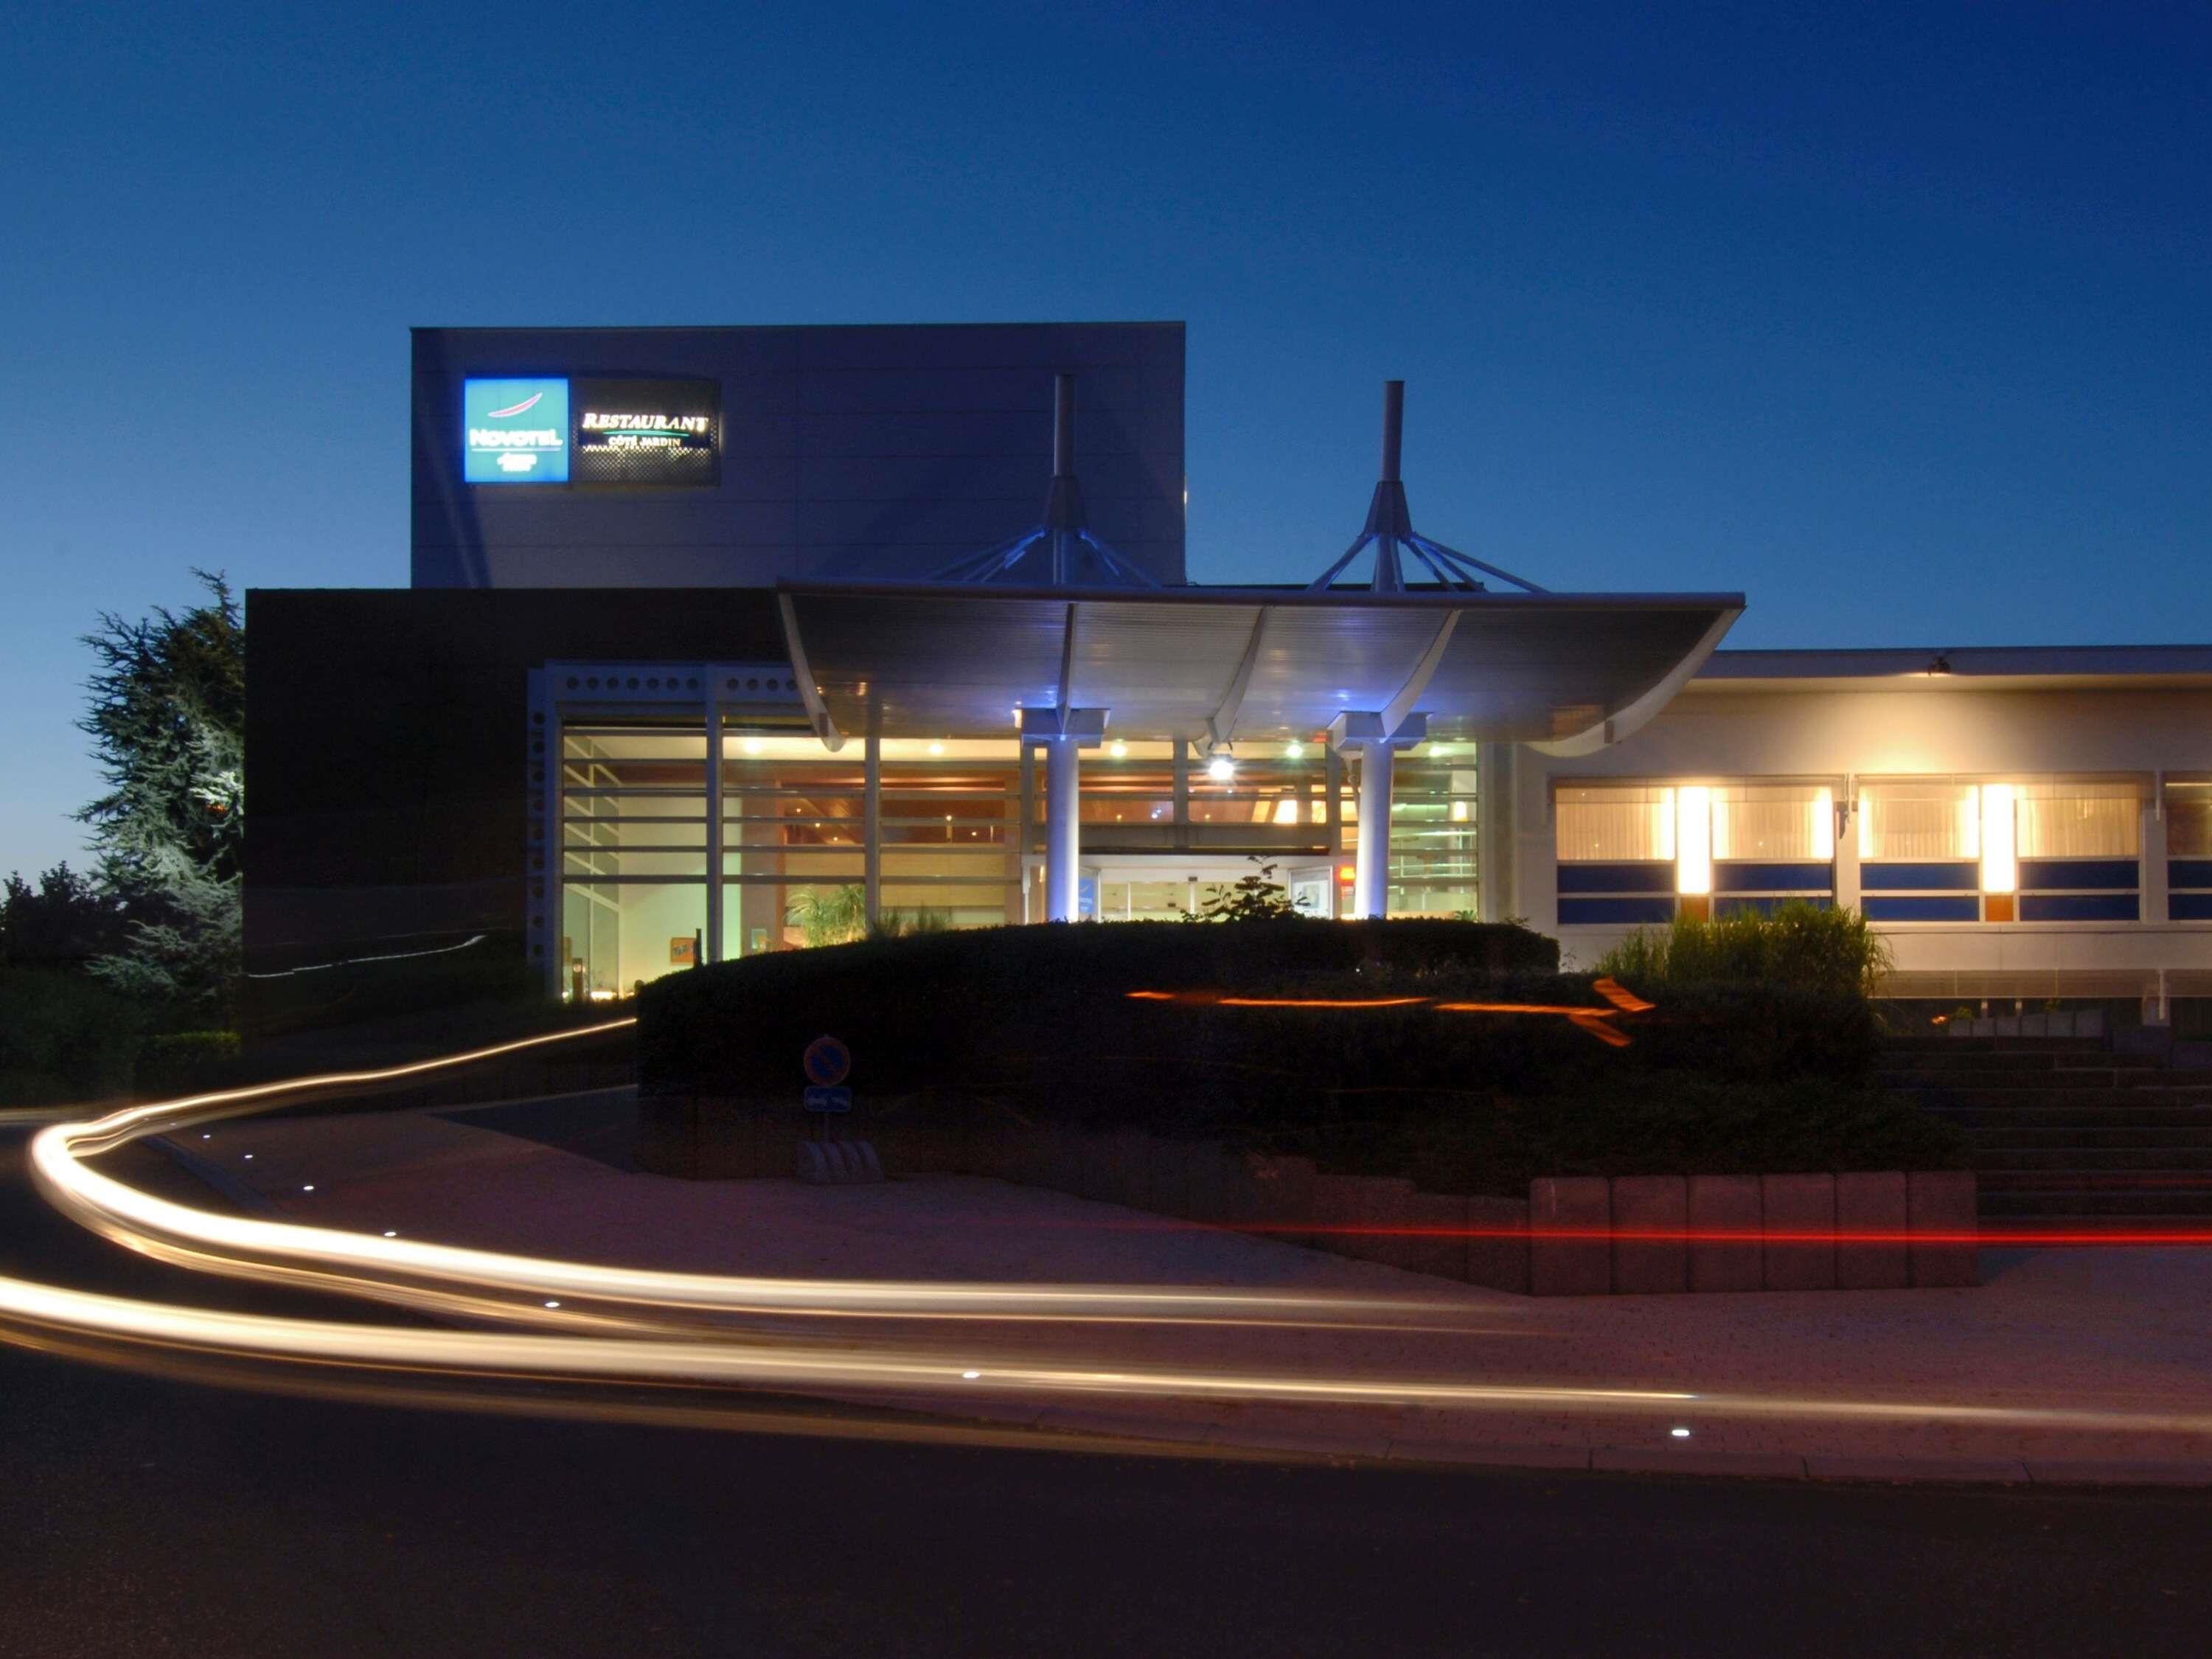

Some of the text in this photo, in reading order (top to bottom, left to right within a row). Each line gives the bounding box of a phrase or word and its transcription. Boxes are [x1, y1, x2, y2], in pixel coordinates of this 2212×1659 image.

[582, 413, 709, 432] RESTAURANT
[469, 428, 563, 446] NOVOTEL
[639, 437, 681, 447] JARDIN
